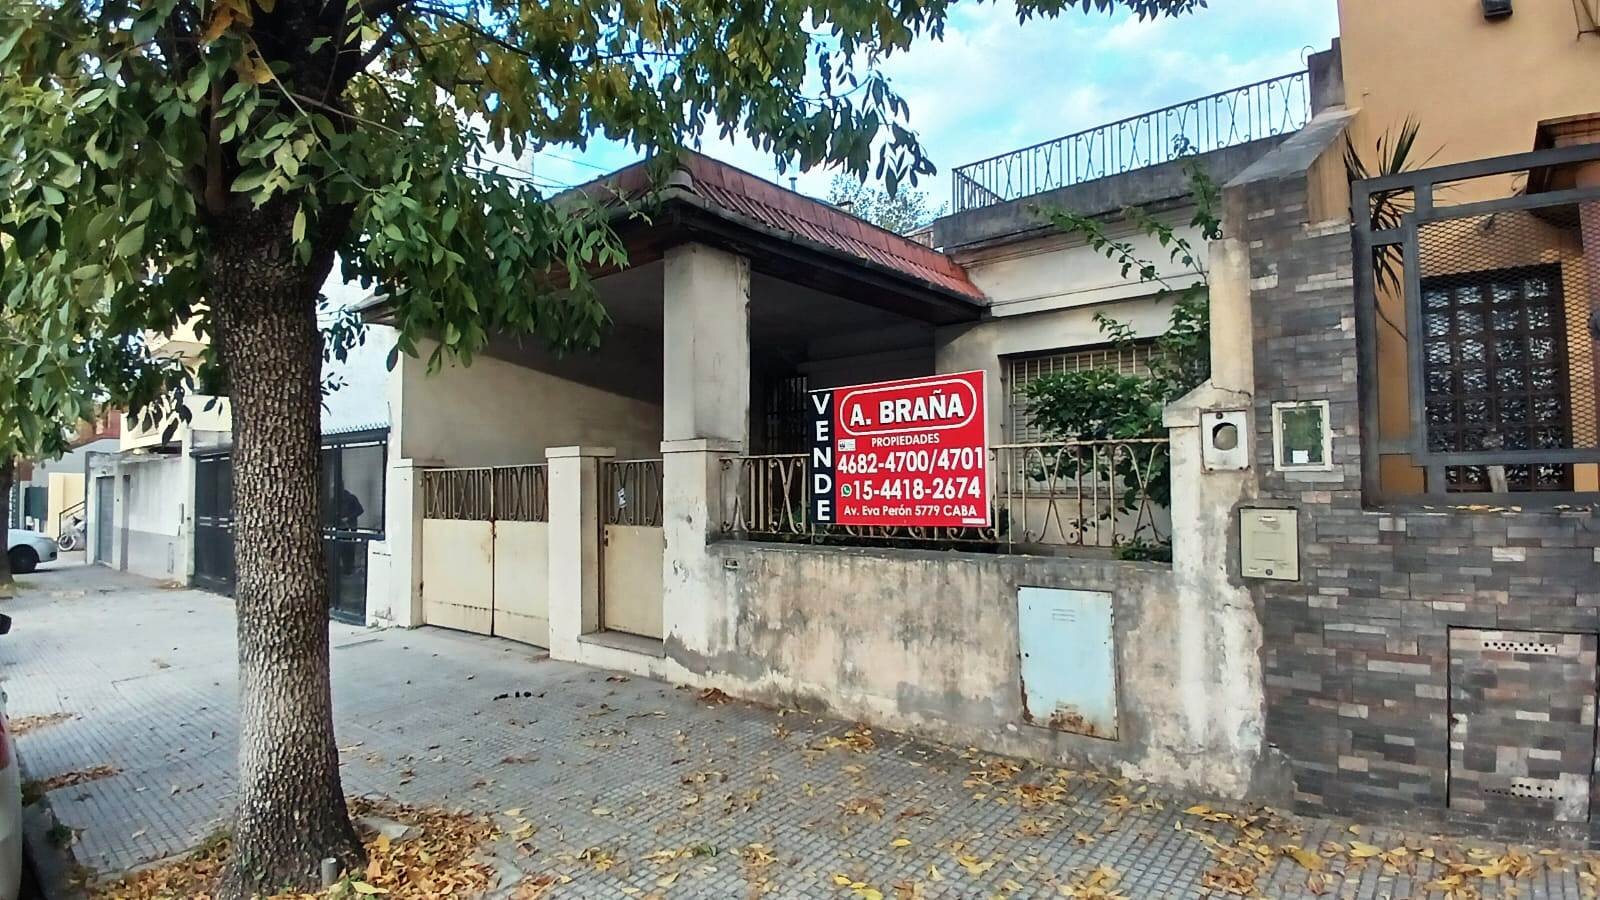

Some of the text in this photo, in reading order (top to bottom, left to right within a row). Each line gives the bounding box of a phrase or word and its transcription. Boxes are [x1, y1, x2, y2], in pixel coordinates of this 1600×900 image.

[850, 389, 965, 426] A. BRAÑA
[871, 433, 940, 448] PROPIEDADES
[812, 393, 832, 521] VENDE
[837, 447, 983, 474] 4682-4700/4701
[853, 476, 981, 500] 15-4418-2674
[844, 504, 977, 517] Av. Eva Perón 5779 CABA
